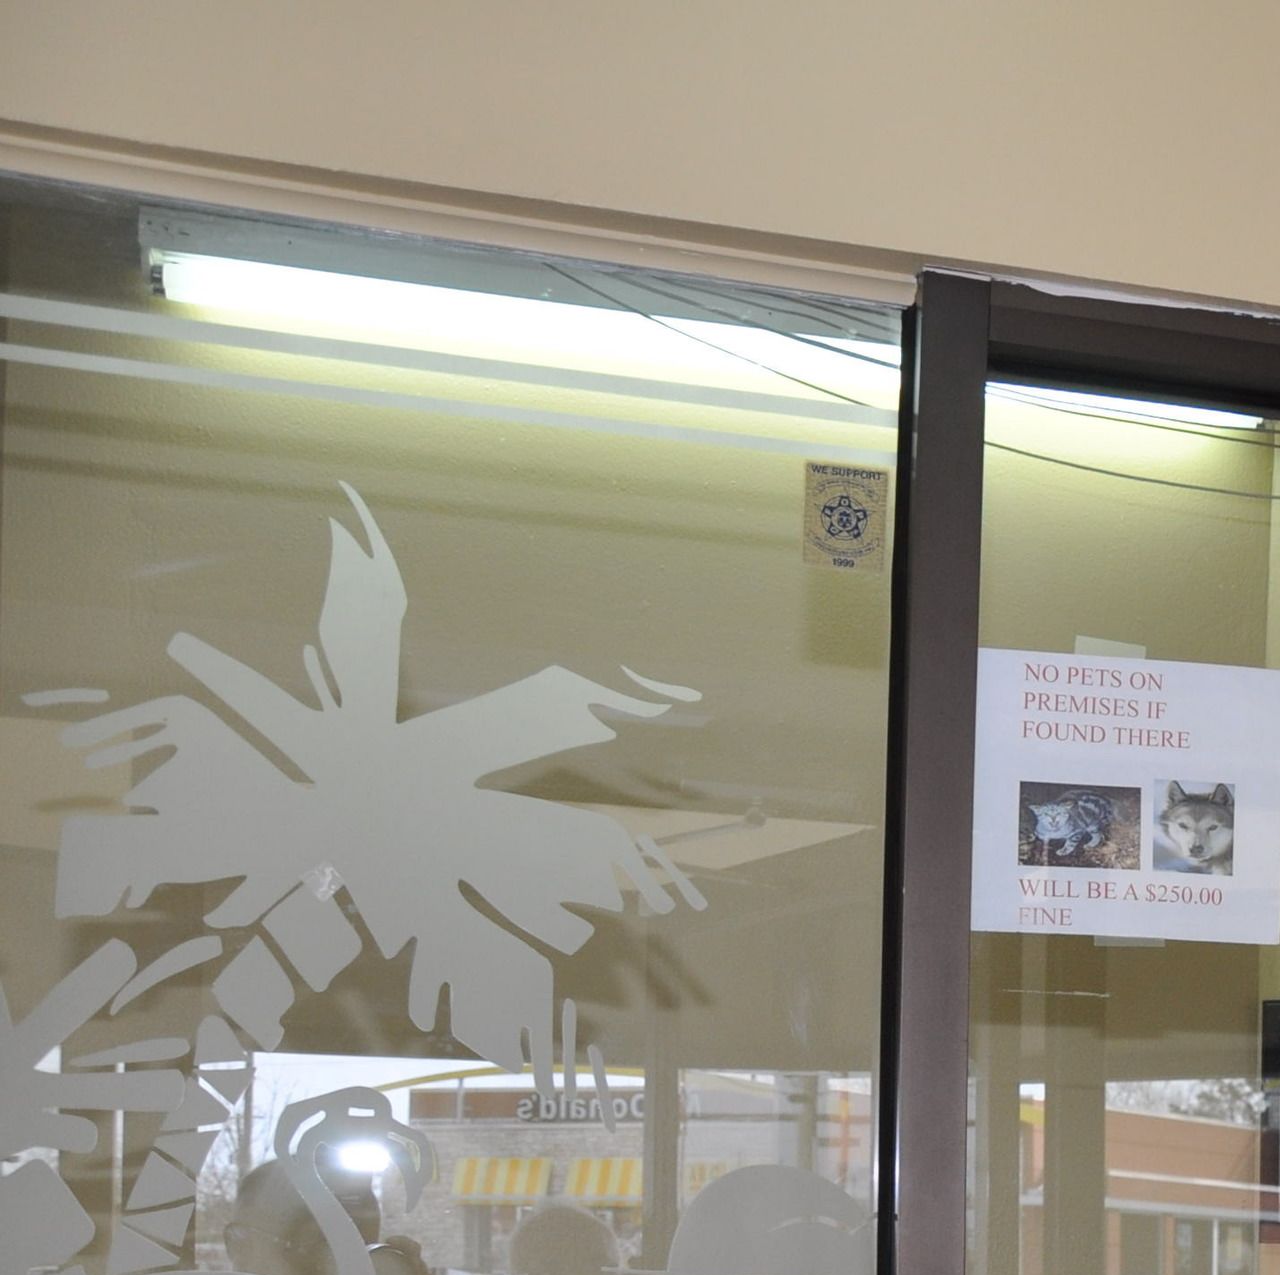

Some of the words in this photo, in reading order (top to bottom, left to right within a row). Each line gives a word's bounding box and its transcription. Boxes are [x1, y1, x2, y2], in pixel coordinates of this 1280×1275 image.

[811, 465, 828, 474] WE
[832, 466, 881, 480] SUPPORT
[1025, 663, 1059, 683] NO
[1067, 667, 1122, 688] PETS
[1129, 672, 1163, 691] ON
[1024, 692, 1138, 718] PREMISES
[1147, 701, 1167, 719] IF
[1022, 721, 1106, 743] FOUND
[1113, 727, 1191, 748] THERE
[1018, 878, 1079, 898] WILL
[1087, 881, 1117, 899] BE
[1123, 884, 1138, 901] A
[1145, 884, 1222, 905] $250.00
[1019, 907, 1073, 926] FINE
